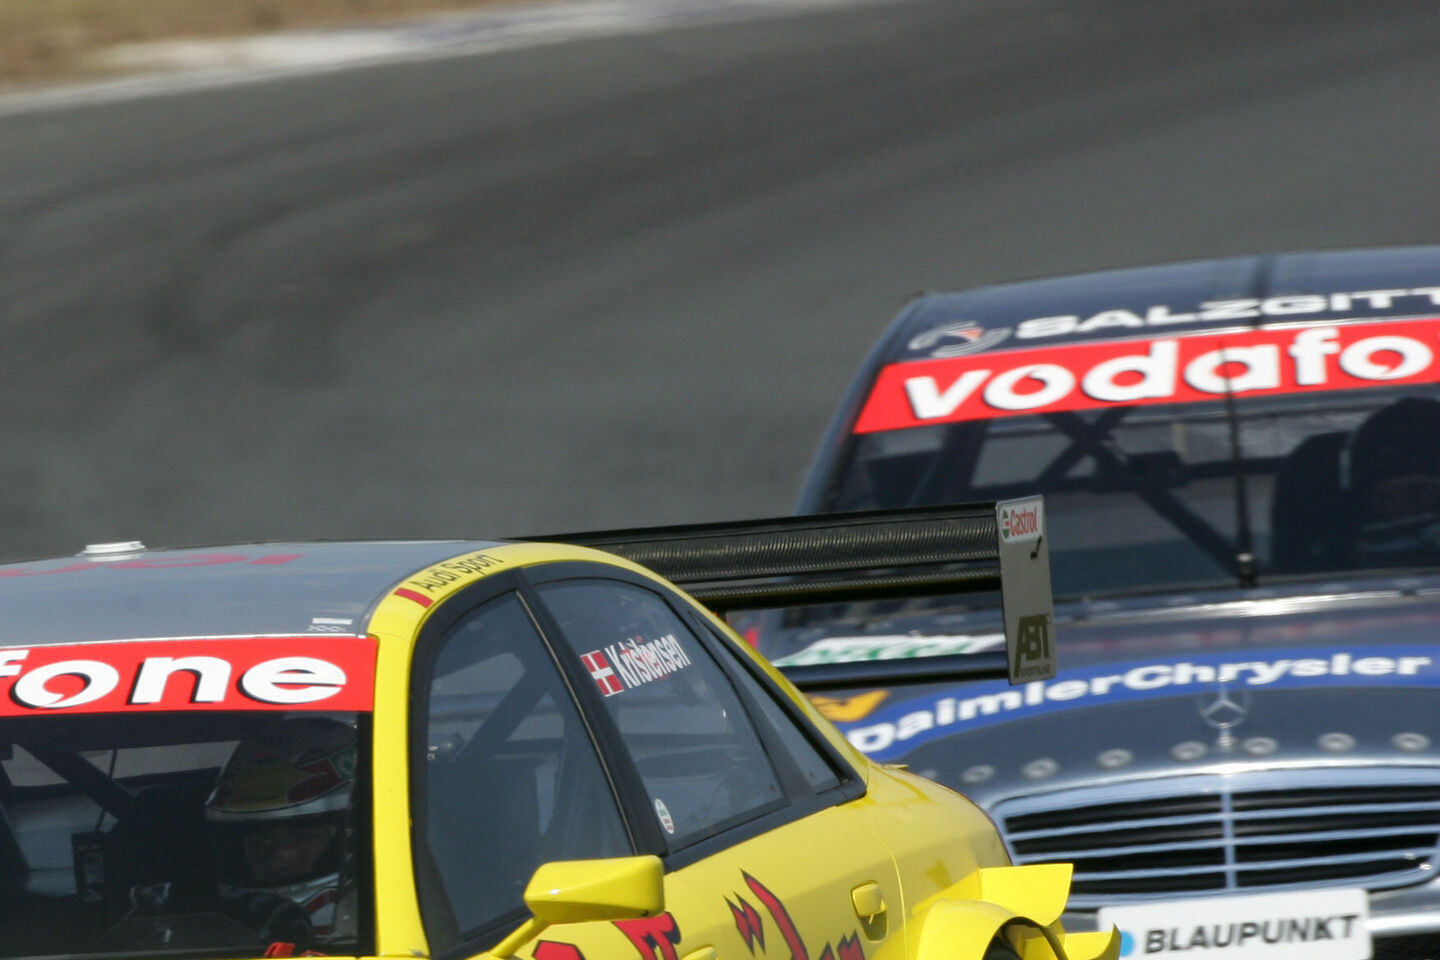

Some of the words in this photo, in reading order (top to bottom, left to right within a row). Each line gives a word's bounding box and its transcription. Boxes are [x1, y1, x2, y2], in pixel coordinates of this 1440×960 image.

[1010, 507, 1038, 537] Castrol
[409, 567, 461, 593] Audi
[441, 554, 504, 576] Sport
[604, 634, 691, 689] Kristensen
[1013, 614, 1050, 678] ABT
[848, 652, 1430, 752] DaimlerChrysler
[1144, 914, 1362, 954] BLAUPUNKT
